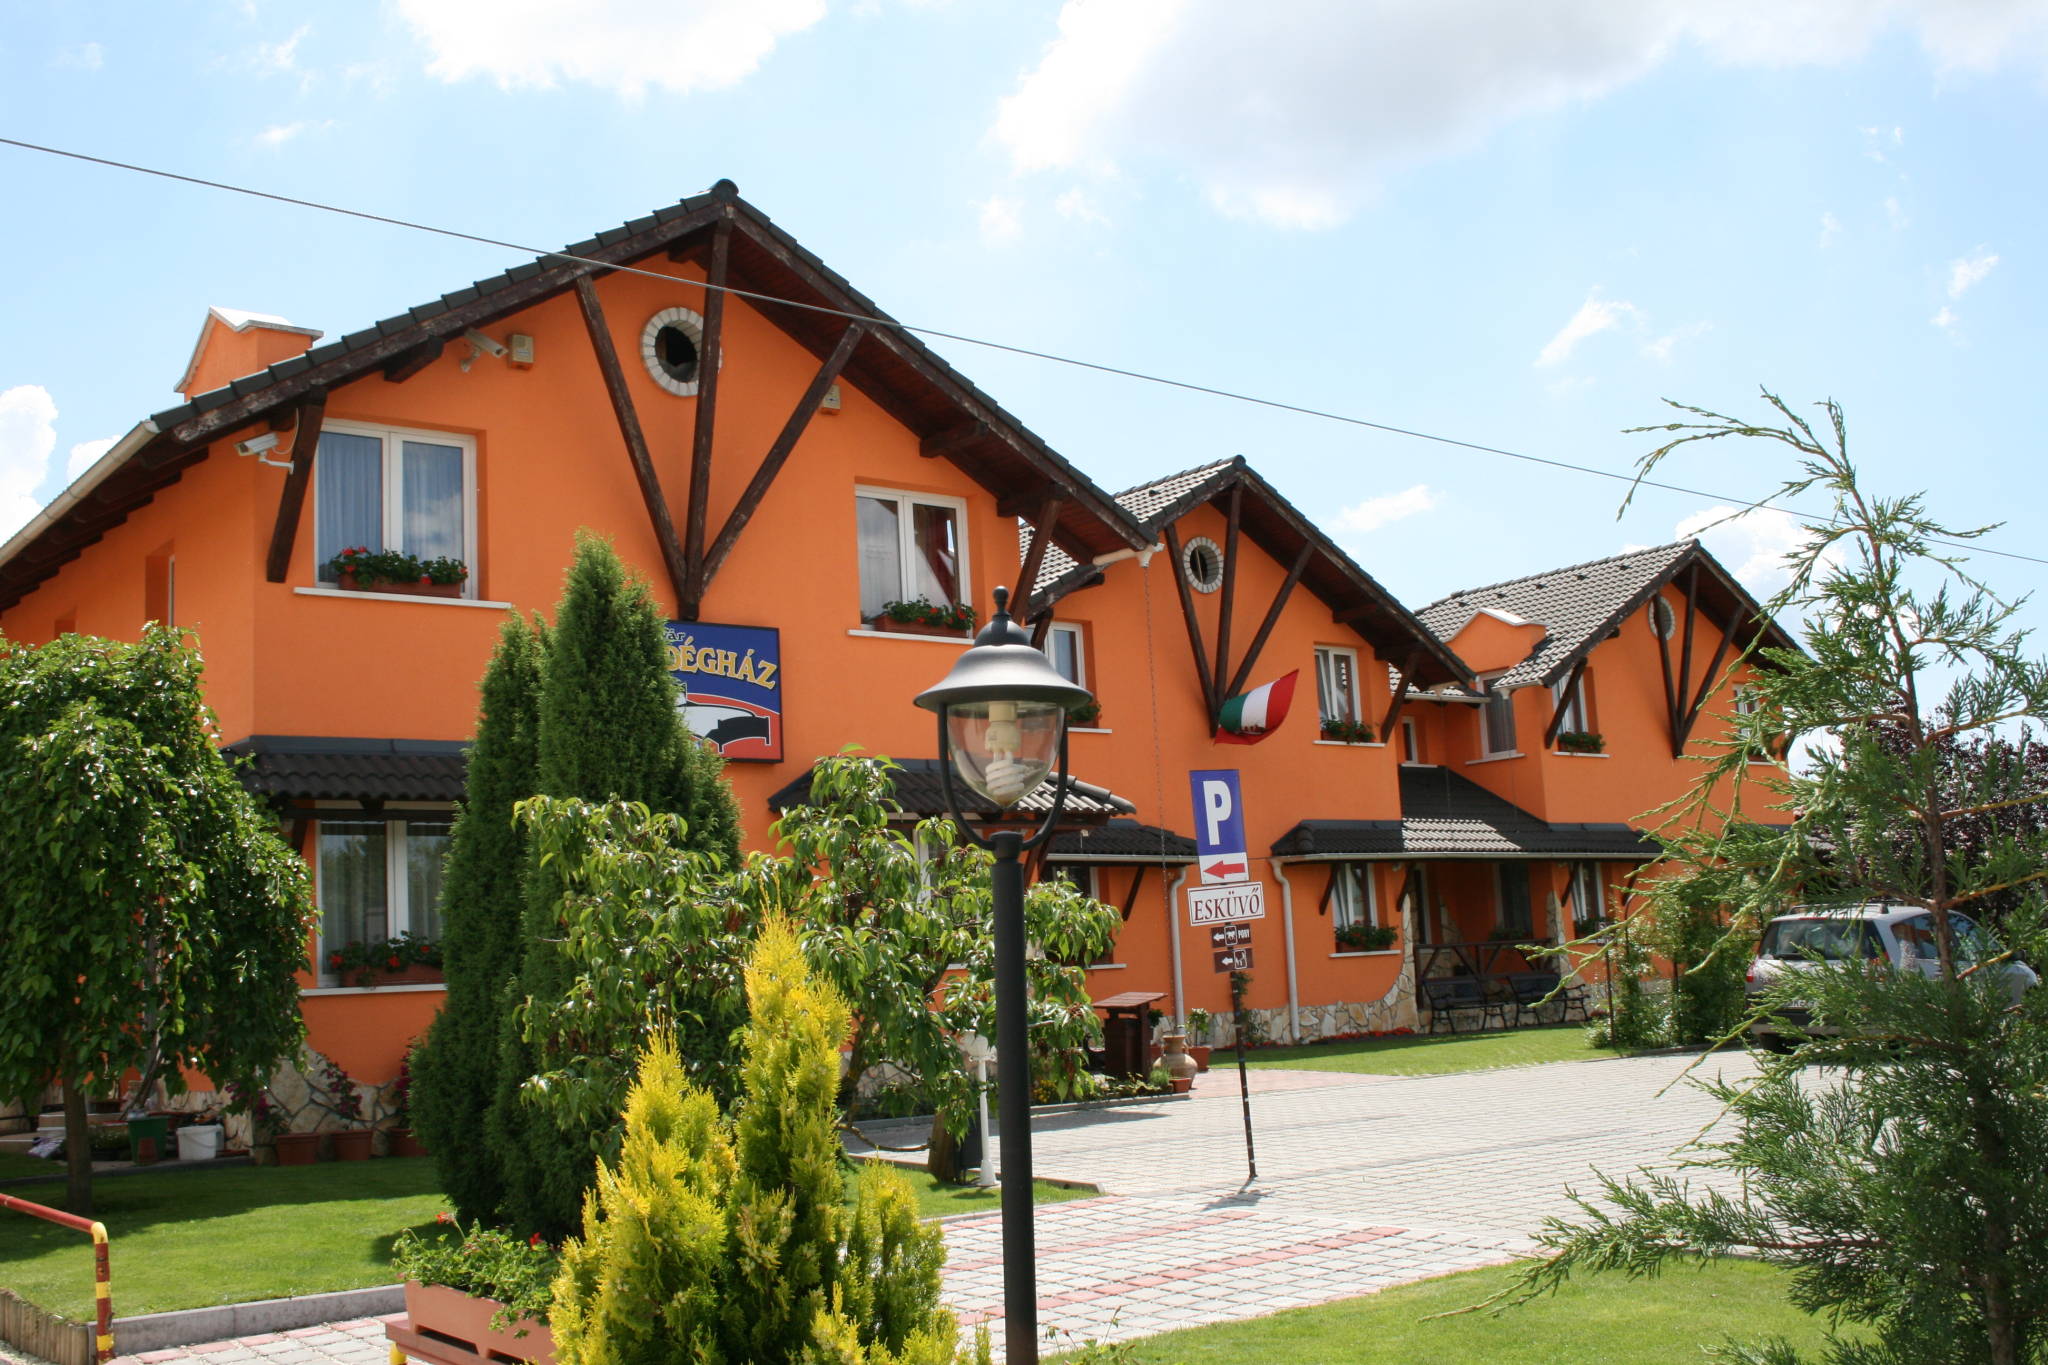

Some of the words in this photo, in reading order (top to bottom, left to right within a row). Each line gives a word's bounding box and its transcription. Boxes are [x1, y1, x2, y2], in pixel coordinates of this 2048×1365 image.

[664, 636, 777, 690] DÉGHÁZ
[1202, 780, 1232, 846] P
[1194, 887, 1260, 921] ESKÜVŐ
